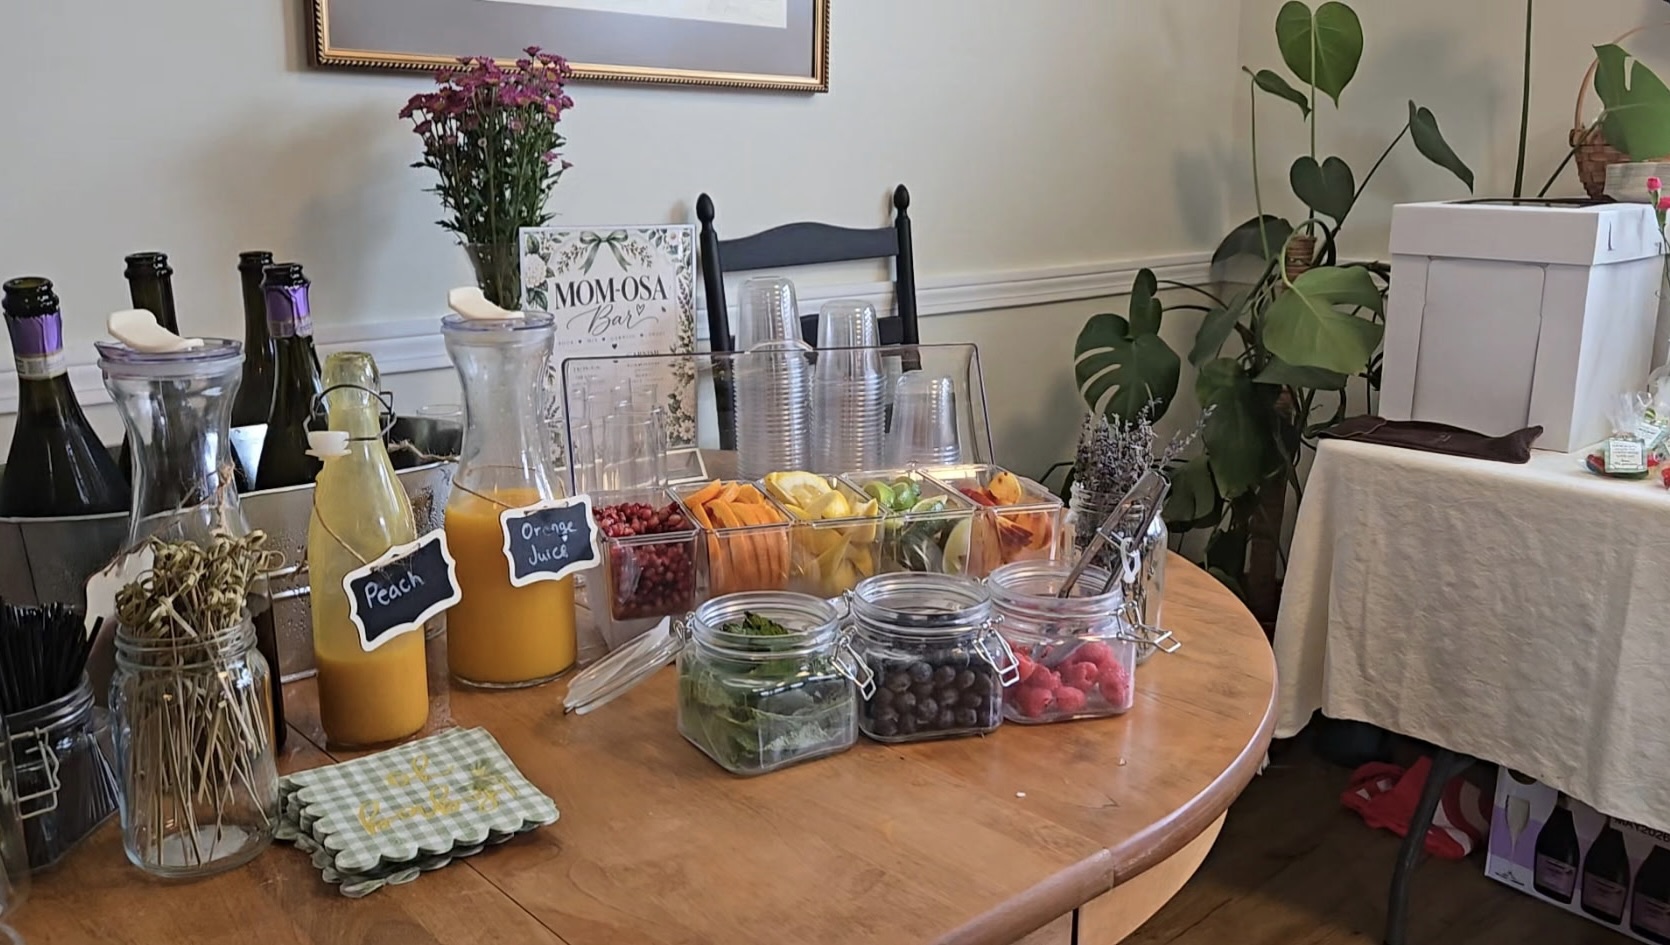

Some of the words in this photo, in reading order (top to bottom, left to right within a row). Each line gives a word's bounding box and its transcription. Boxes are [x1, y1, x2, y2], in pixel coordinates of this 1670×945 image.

[555, 275, 668, 310] MOM-OSA
[566, 303, 659, 336] Bar
[521, 519, 577, 540] Orange
[528, 543, 569, 566] Juice
[364, 570, 425, 609] Peach
